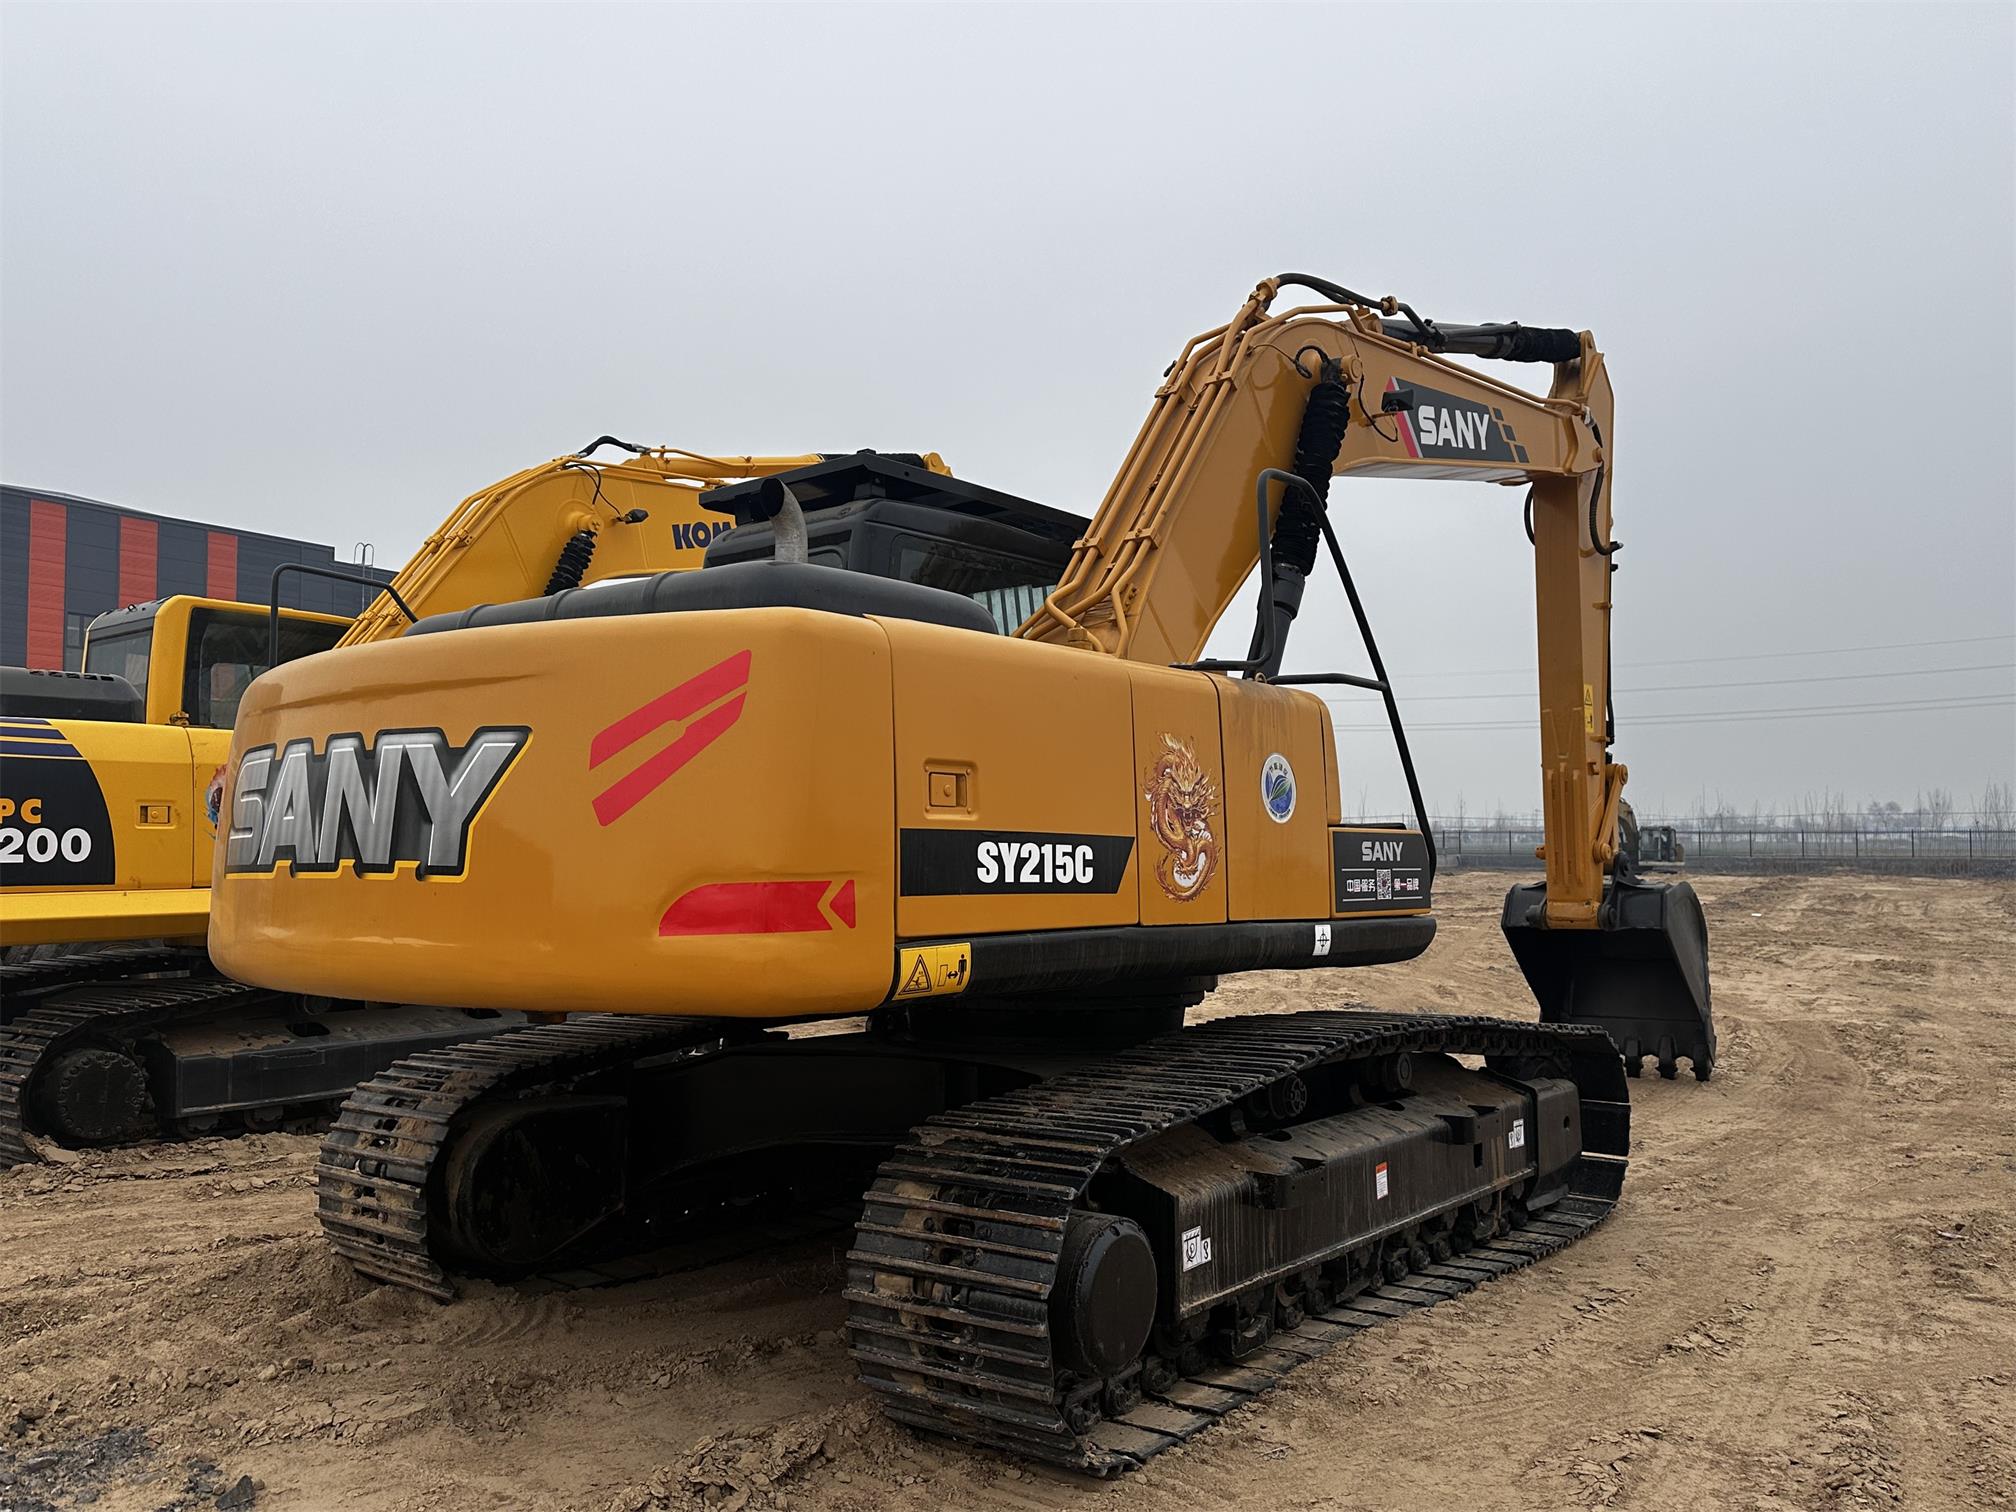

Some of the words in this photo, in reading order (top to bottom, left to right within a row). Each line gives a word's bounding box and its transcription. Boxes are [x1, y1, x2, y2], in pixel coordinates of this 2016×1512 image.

[1418, 405, 1489, 450] SANY
[0, 798, 42, 824] PC
[226, 728, 522, 868] SANY
[0, 827, 92, 863] 200
[977, 841, 1094, 884] SY215C
[1361, 841, 1403, 862] SANY
